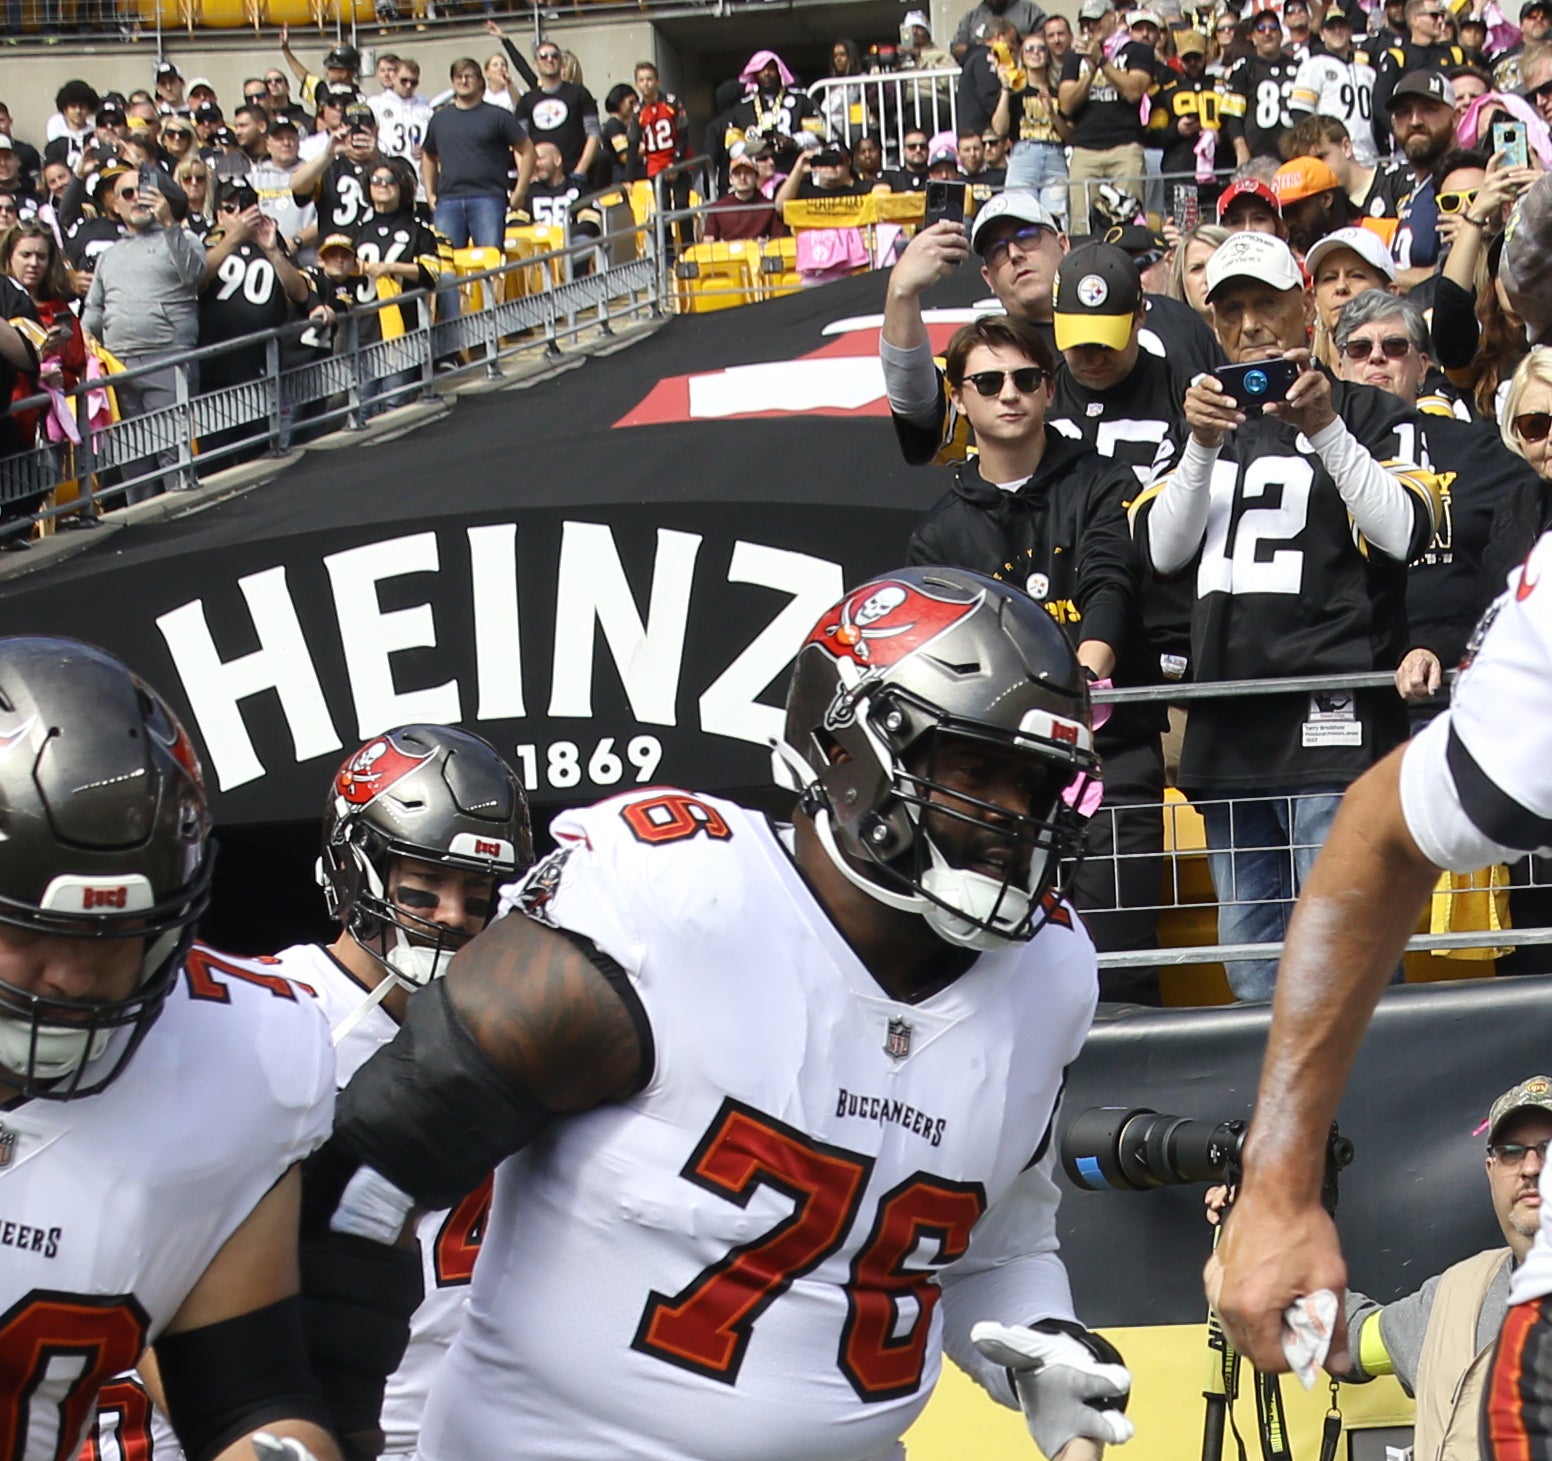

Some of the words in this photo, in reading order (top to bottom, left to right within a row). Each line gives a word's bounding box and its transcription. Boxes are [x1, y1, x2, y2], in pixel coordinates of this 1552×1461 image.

[1172, 91, 1222, 131] 90
[1340, 83, 1371, 121] 90
[645, 118, 674, 152] 12
[217, 254, 275, 305] 90
[1197, 456, 1314, 599] 12
[155, 520, 846, 793] HEINZ
[517, 735, 664, 791] 1869
[835, 1087, 947, 1148] BUCCANEERS
[631, 1095, 987, 1403] 76
